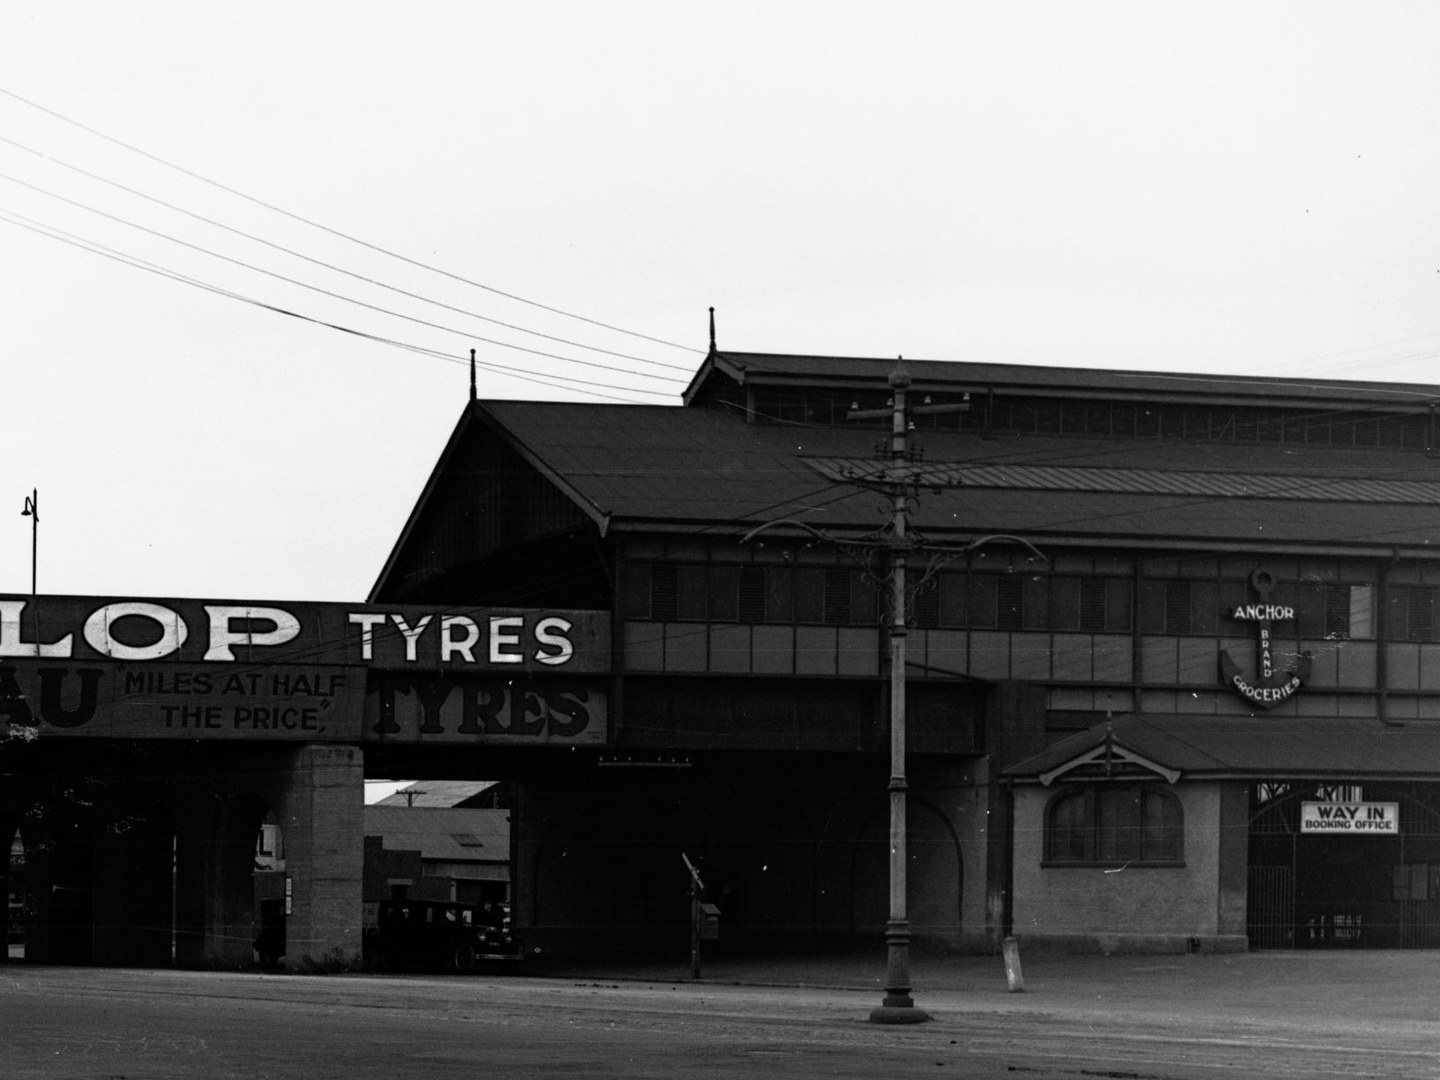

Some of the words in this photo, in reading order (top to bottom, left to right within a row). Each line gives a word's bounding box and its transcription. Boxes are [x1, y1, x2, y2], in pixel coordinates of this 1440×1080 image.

[1234, 604, 1294, 620] ANCHOR
[348, 612, 574, 665] TYRES
[1261, 629, 1272, 678] BRAND
[226, 673, 263, 696] AT
[272, 674, 346, 698] HALF
[1233, 675, 1300, 701] GROCERIES
[160, 705, 220, 729] THE
[370, 680, 590, 738] TYRES
[1305, 820, 1351, 829] BOOKING
[1355, 820, 1392, 829] OFFICE
[1317, 806, 1359, 820] WAY
[1367, 806, 1384, 820] IN
